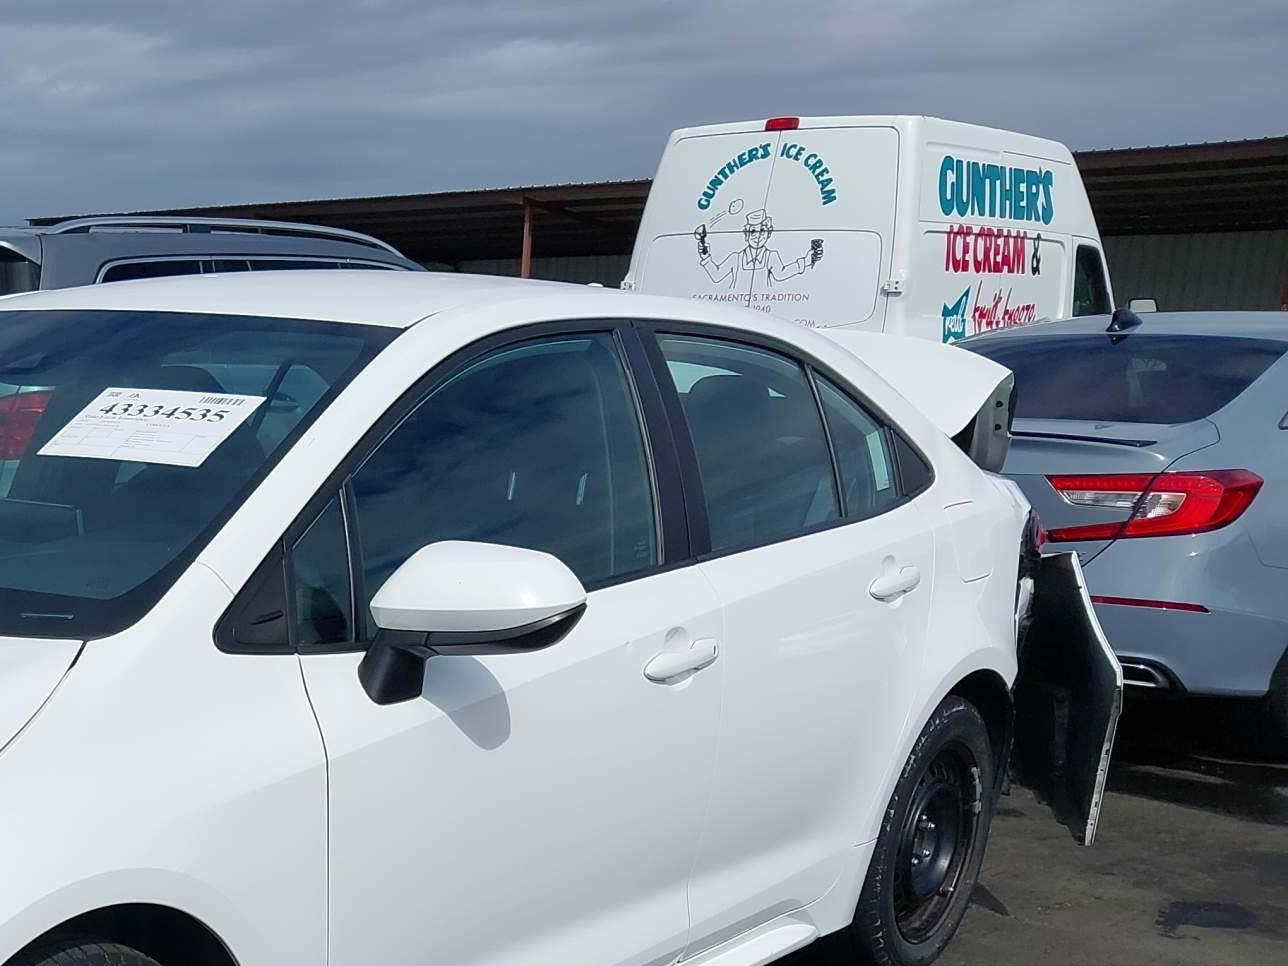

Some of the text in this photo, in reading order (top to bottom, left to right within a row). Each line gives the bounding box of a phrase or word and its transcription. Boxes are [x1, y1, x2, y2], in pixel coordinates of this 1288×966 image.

[697, 142, 837, 210] GUNTHER'S ICE CREAM
[939, 155, 1054, 226] GUNTHER'S
[945, 223, 1042, 276] ICE CREAM &
[760, 293, 810, 302] TRADITION
[99, 402, 231, 423] 43334535
